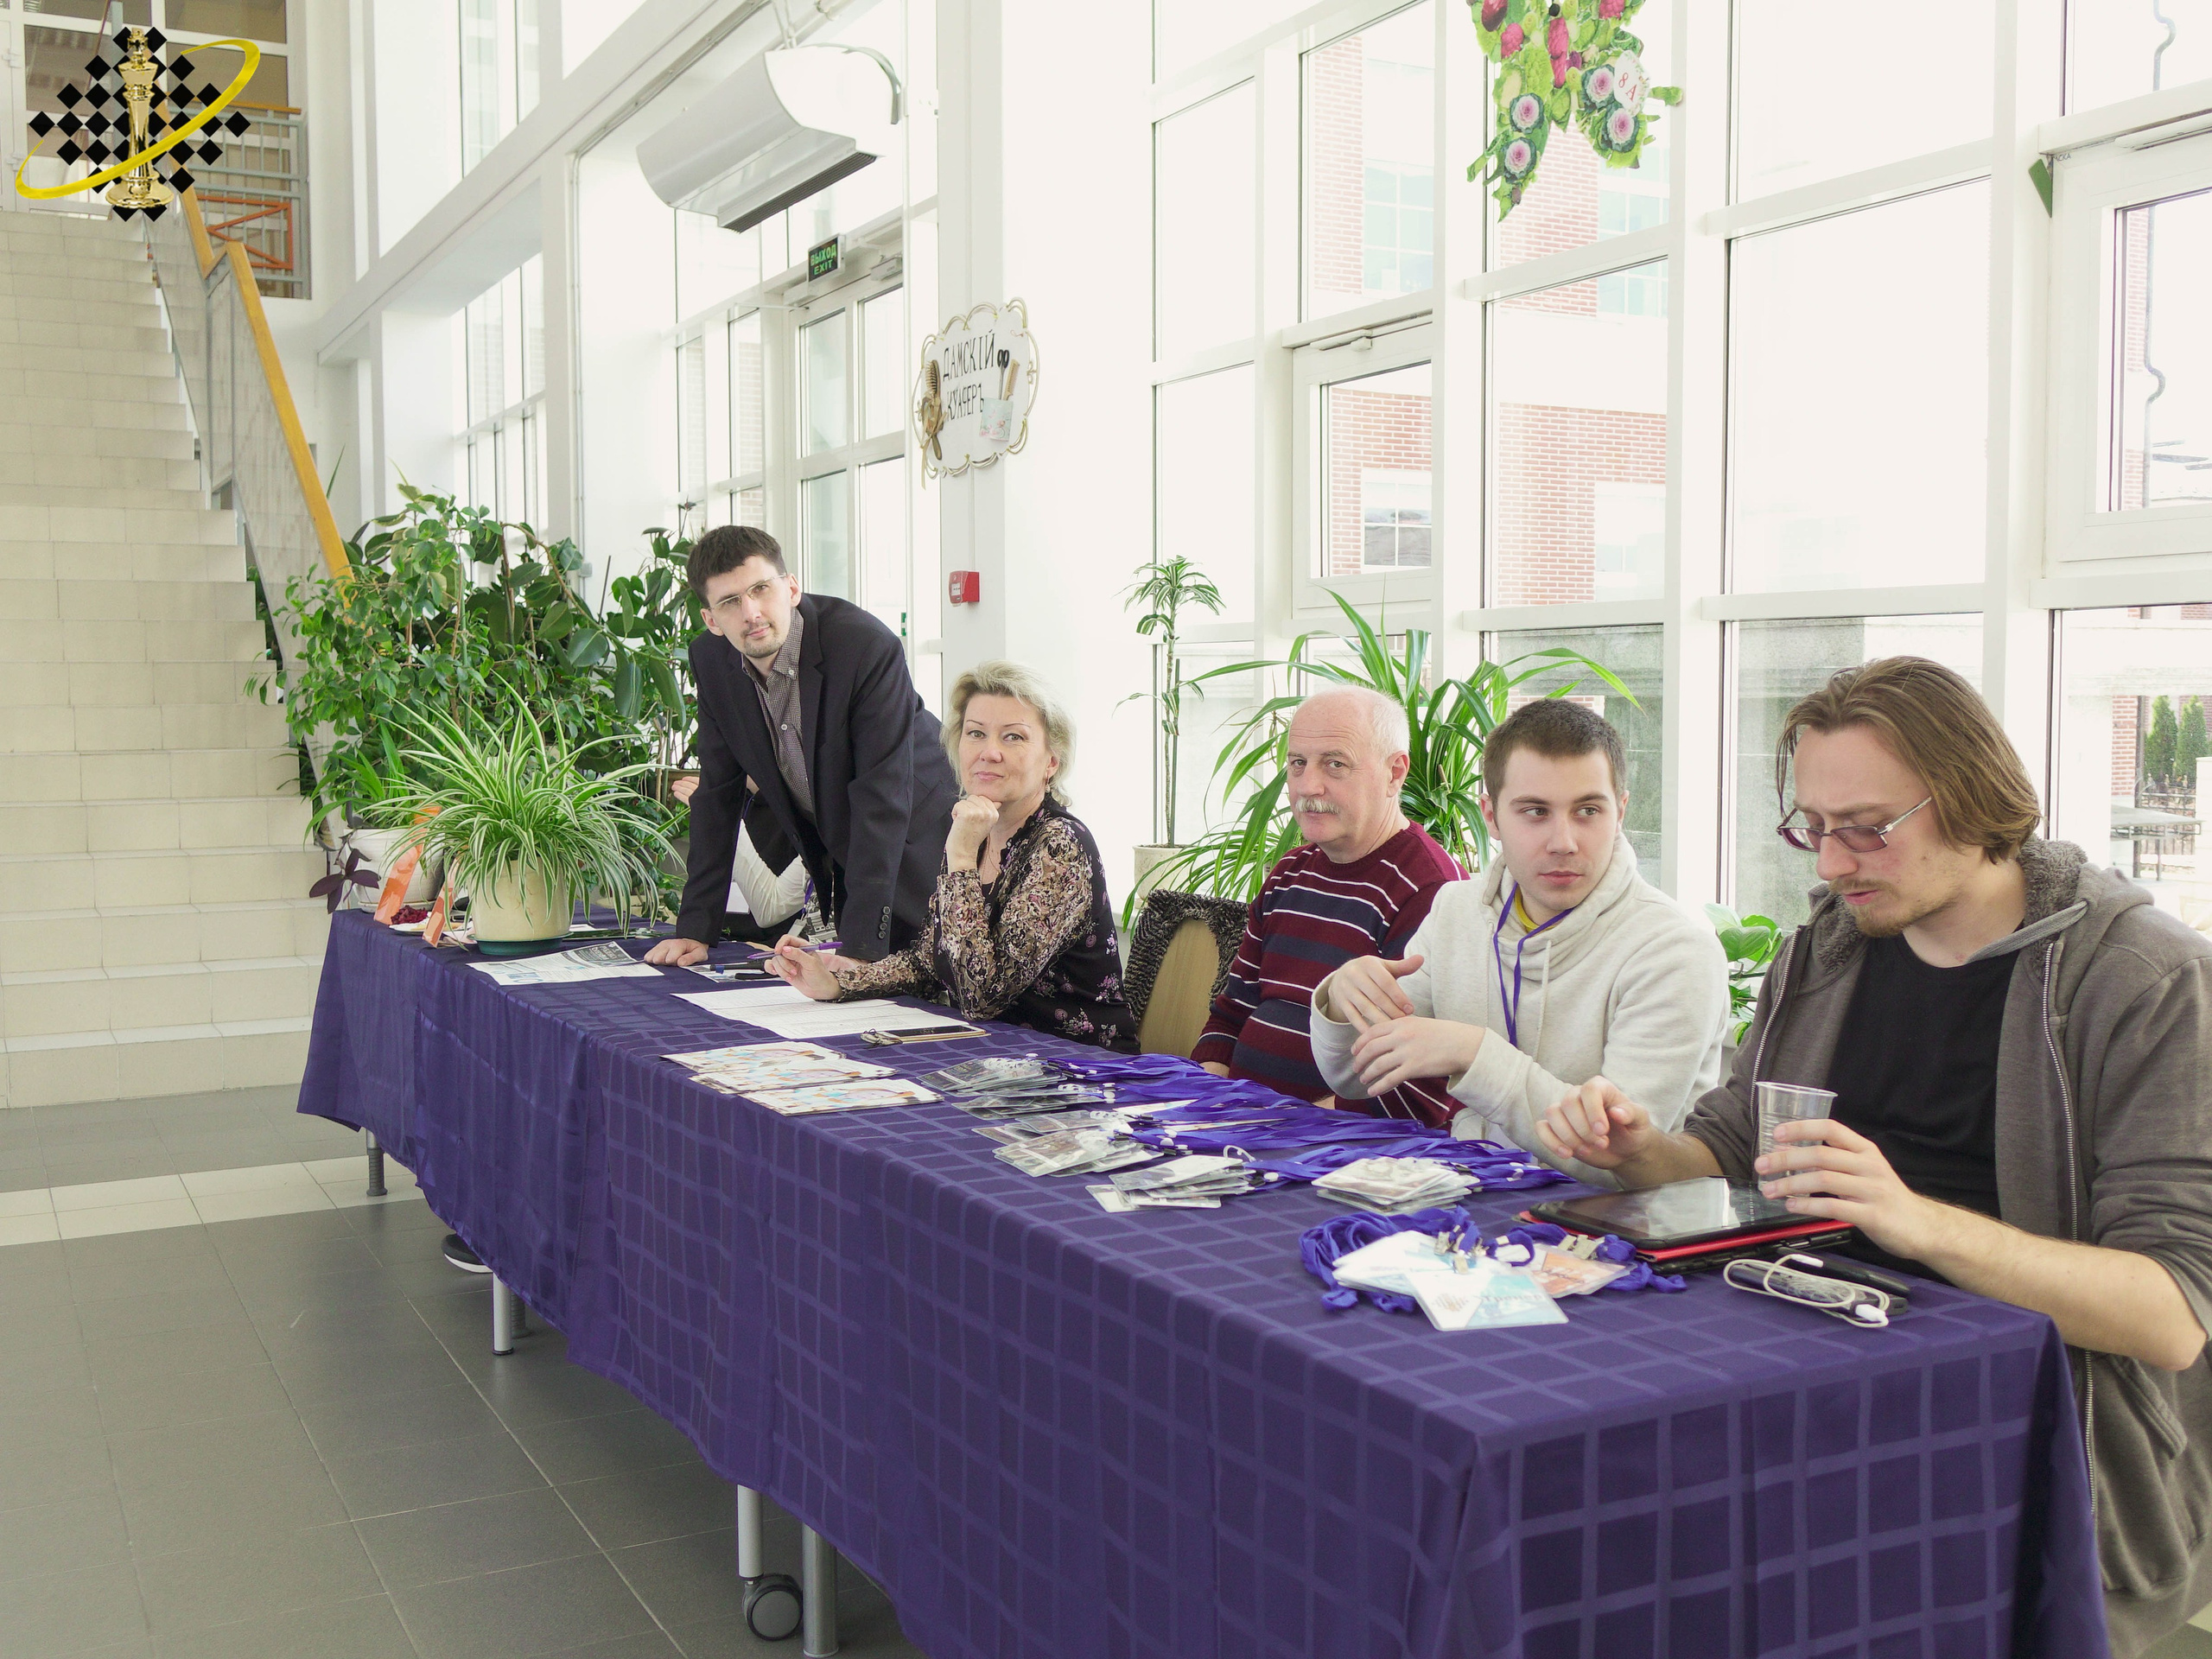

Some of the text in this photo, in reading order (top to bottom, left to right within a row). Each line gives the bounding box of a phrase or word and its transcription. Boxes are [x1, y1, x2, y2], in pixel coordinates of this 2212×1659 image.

[1618, 72, 1629, 88] 8
[810, 244, 836, 266] ВЫХОД
[814, 259, 833, 275] EXIT
